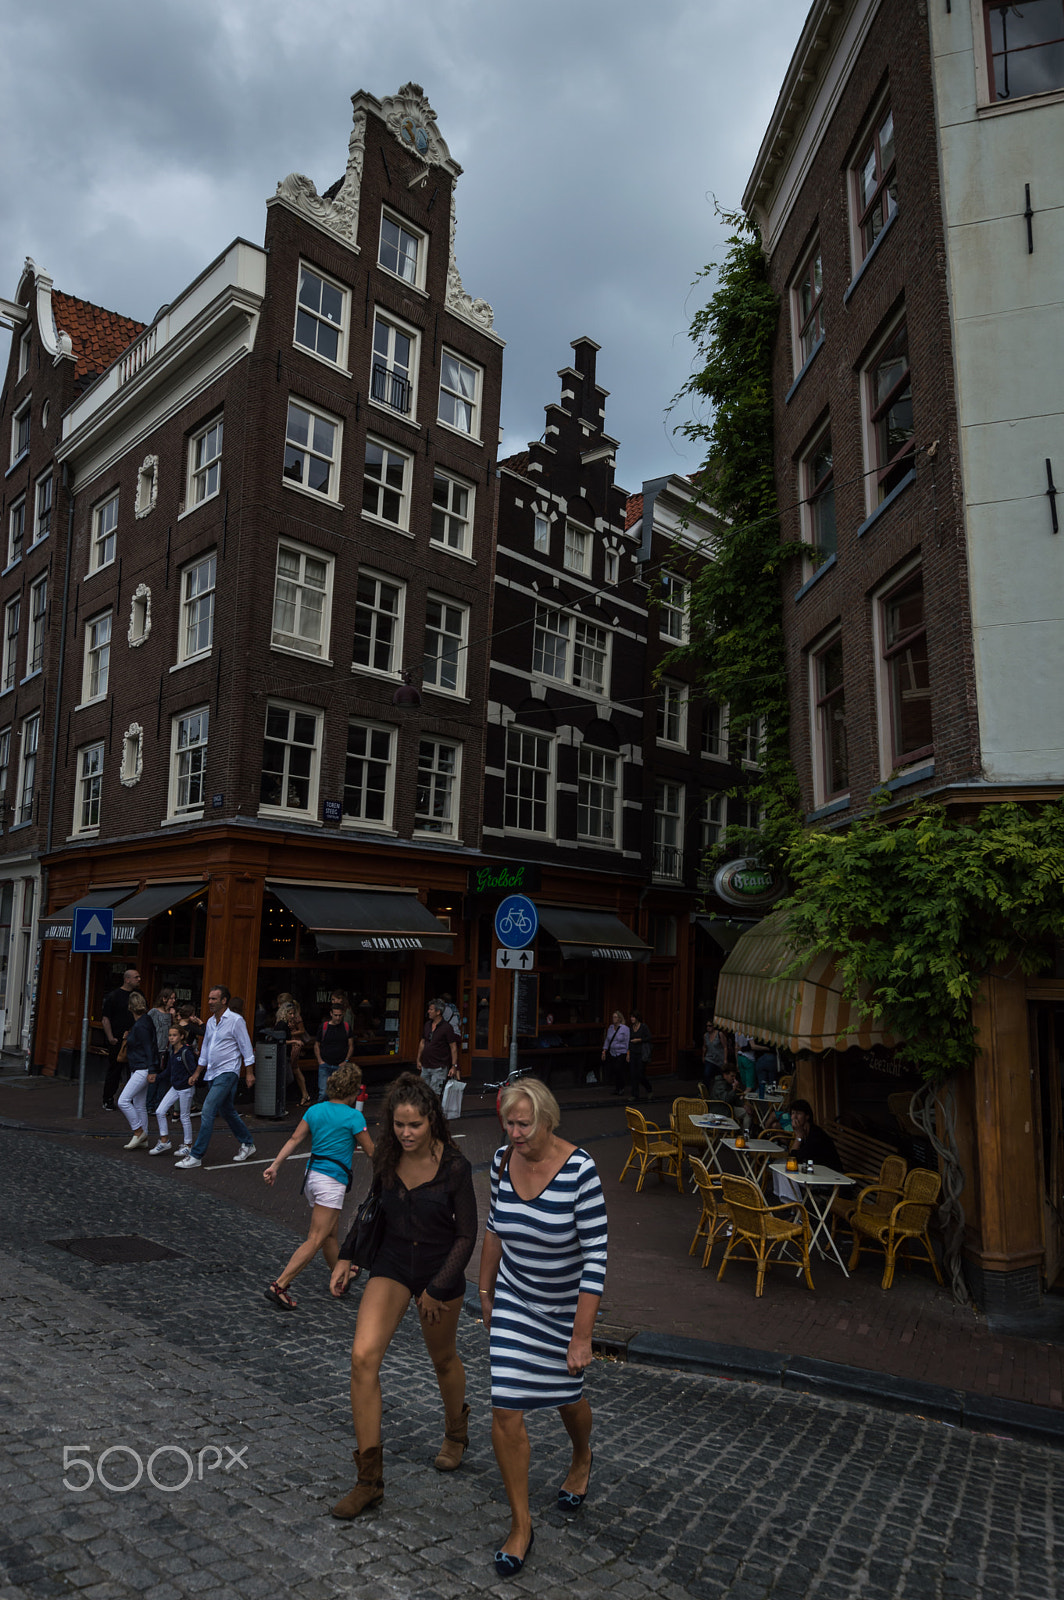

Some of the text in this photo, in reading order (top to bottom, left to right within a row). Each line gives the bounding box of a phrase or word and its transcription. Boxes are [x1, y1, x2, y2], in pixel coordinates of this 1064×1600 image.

[476, 867, 525, 892] Grolsch
[734, 873, 774, 889] Brand
[371, 937, 391, 949] VAN
[390, 937, 423, 949] ZUYLEN
